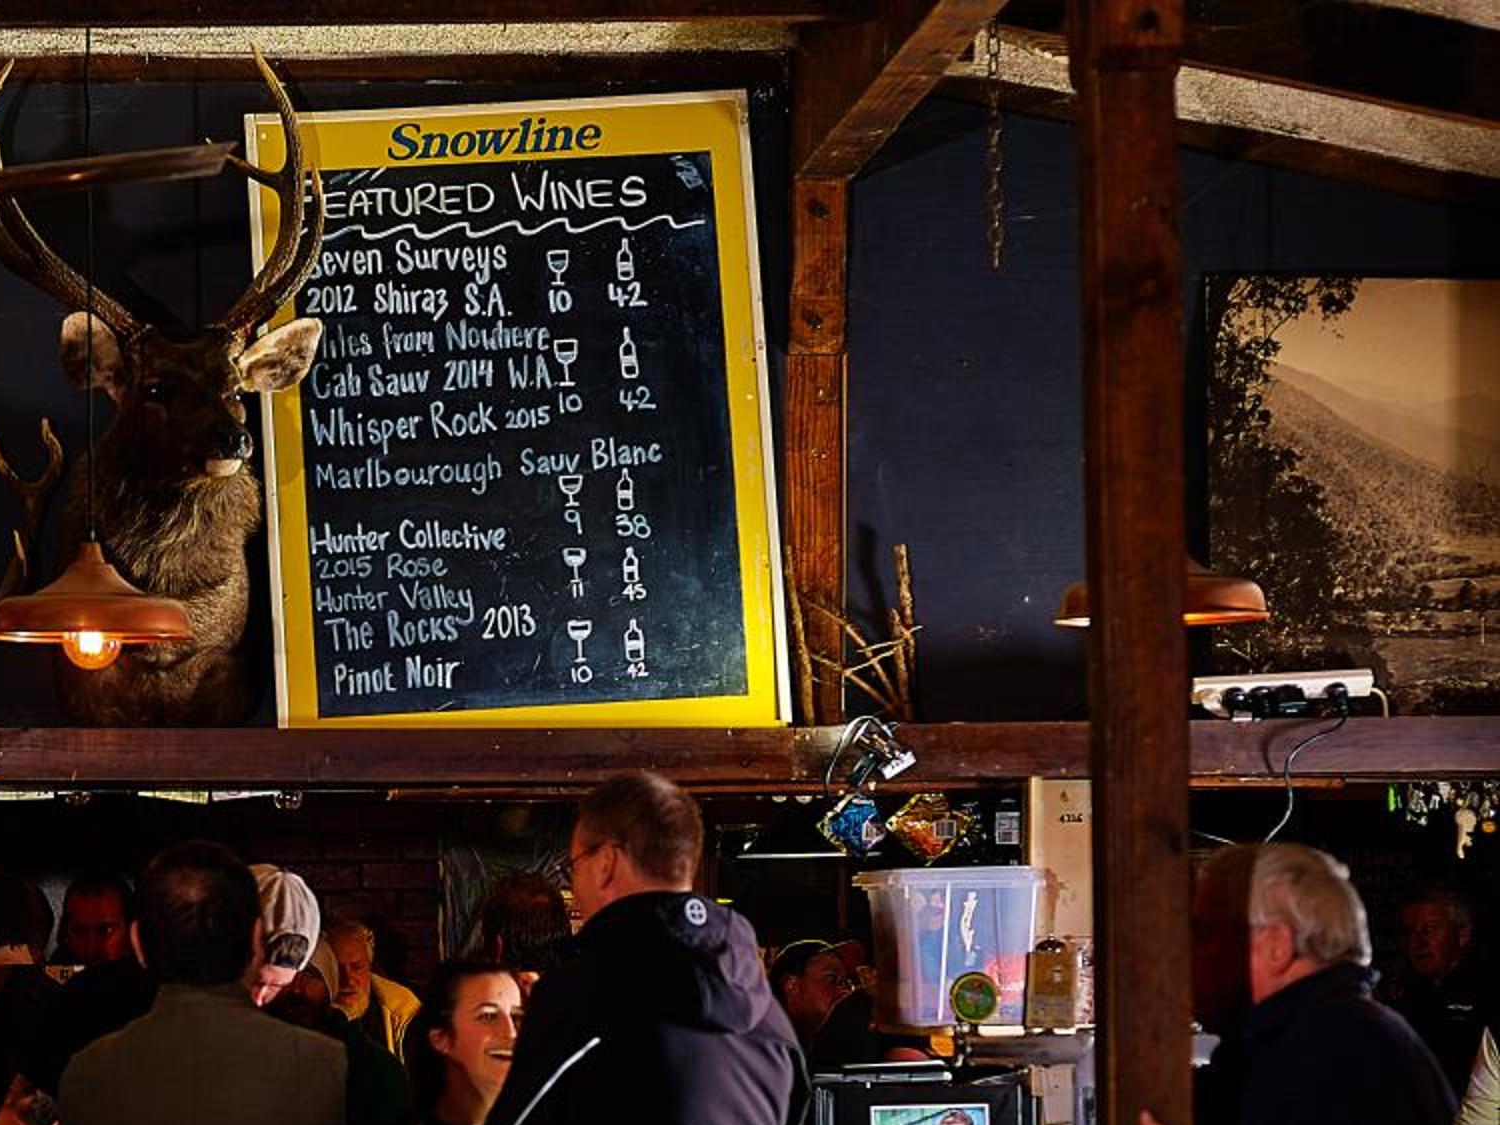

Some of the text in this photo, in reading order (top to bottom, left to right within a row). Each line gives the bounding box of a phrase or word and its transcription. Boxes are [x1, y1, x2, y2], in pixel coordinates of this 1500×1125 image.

[387, 117, 602, 161] Snowline
[511, 169, 647, 211] WINES
[395, 239, 508, 285] Surveys
[306, 280, 513, 322] 2012 Shiraz S.A.
[548, 289, 573, 313] 10
[607, 281, 649, 307] 42
[322, 322, 373, 359] iles
[382, 320, 435, 360] from
[311, 362, 362, 399] Cab
[367, 362, 431, 397] Sauv
[443, 358, 494, 391] 2014
[559, 391, 583, 414] 10
[619, 386, 658, 412] 42
[309, 400, 551, 455] Whisper Rock 2015
[315, 437, 663, 495] Marlbourough Sauv Blanc
[310, 519, 507, 554] Hunter Collective
[564, 509, 584, 535] 9
[616, 513, 652, 538] 38
[316, 552, 448, 579] 2015 Rose
[315, 580, 475, 624] Hunter Valley
[622, 583, 647, 601] 45
[323, 618, 373, 651] The
[481, 603, 536, 639] 2013
[334, 655, 461, 696] Pinot Noir
[571, 665, 592, 683] 10
